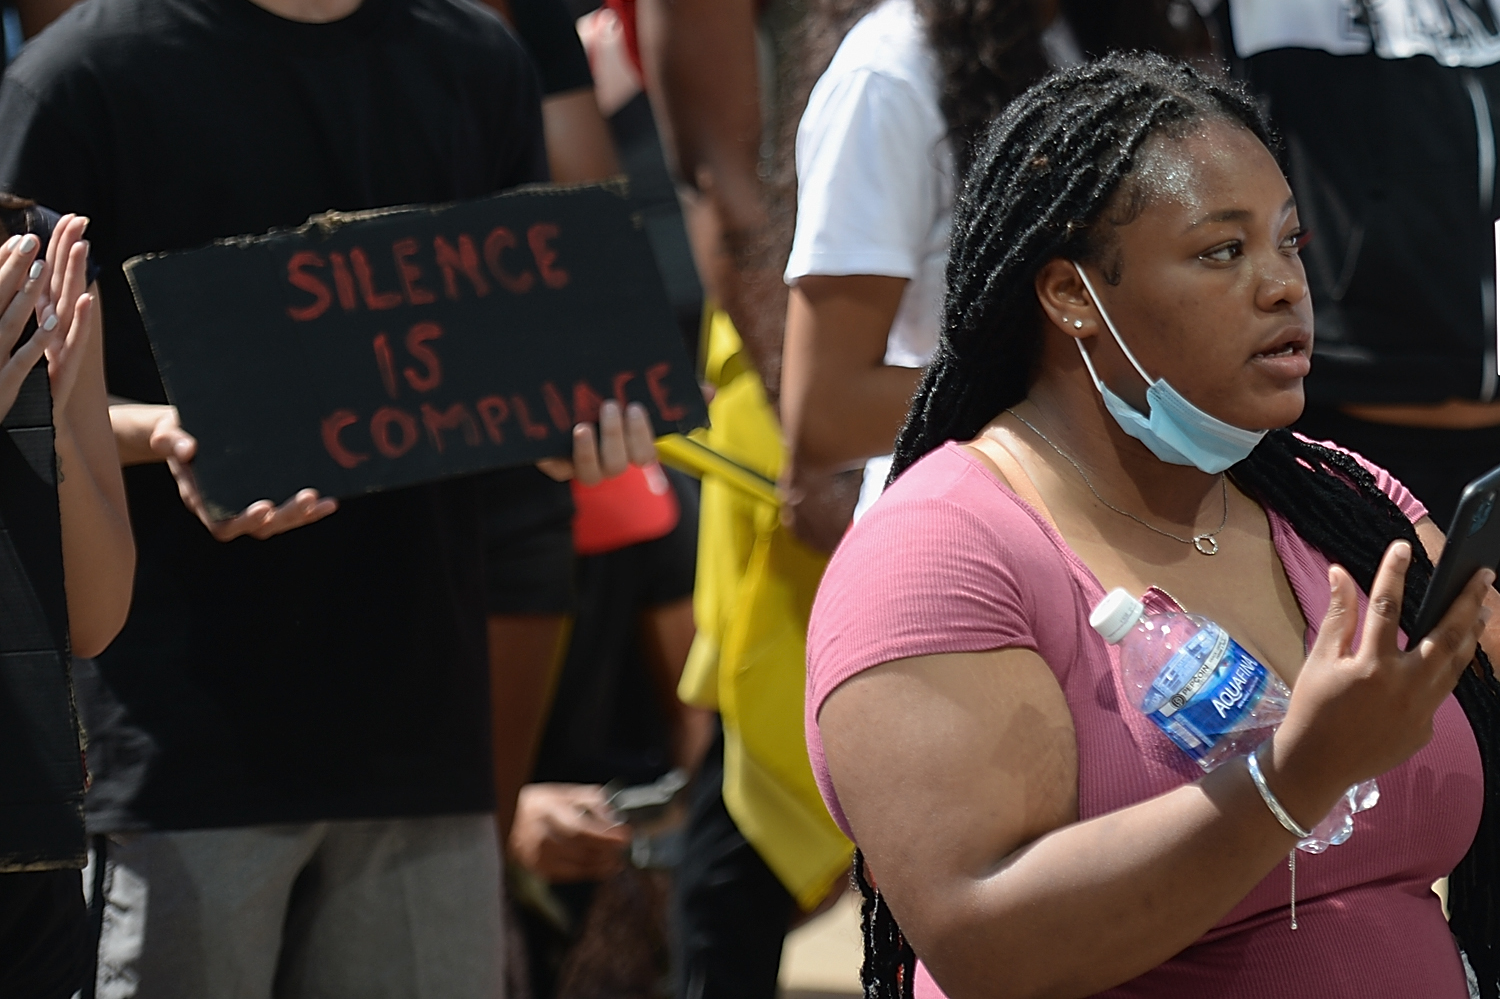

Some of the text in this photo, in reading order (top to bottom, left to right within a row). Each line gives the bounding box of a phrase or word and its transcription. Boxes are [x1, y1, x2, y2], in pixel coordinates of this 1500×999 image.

[286, 223, 570, 322] SILENCE
[373, 321, 442, 398] IS
[1211, 653, 1259, 720] AQUAFINA
